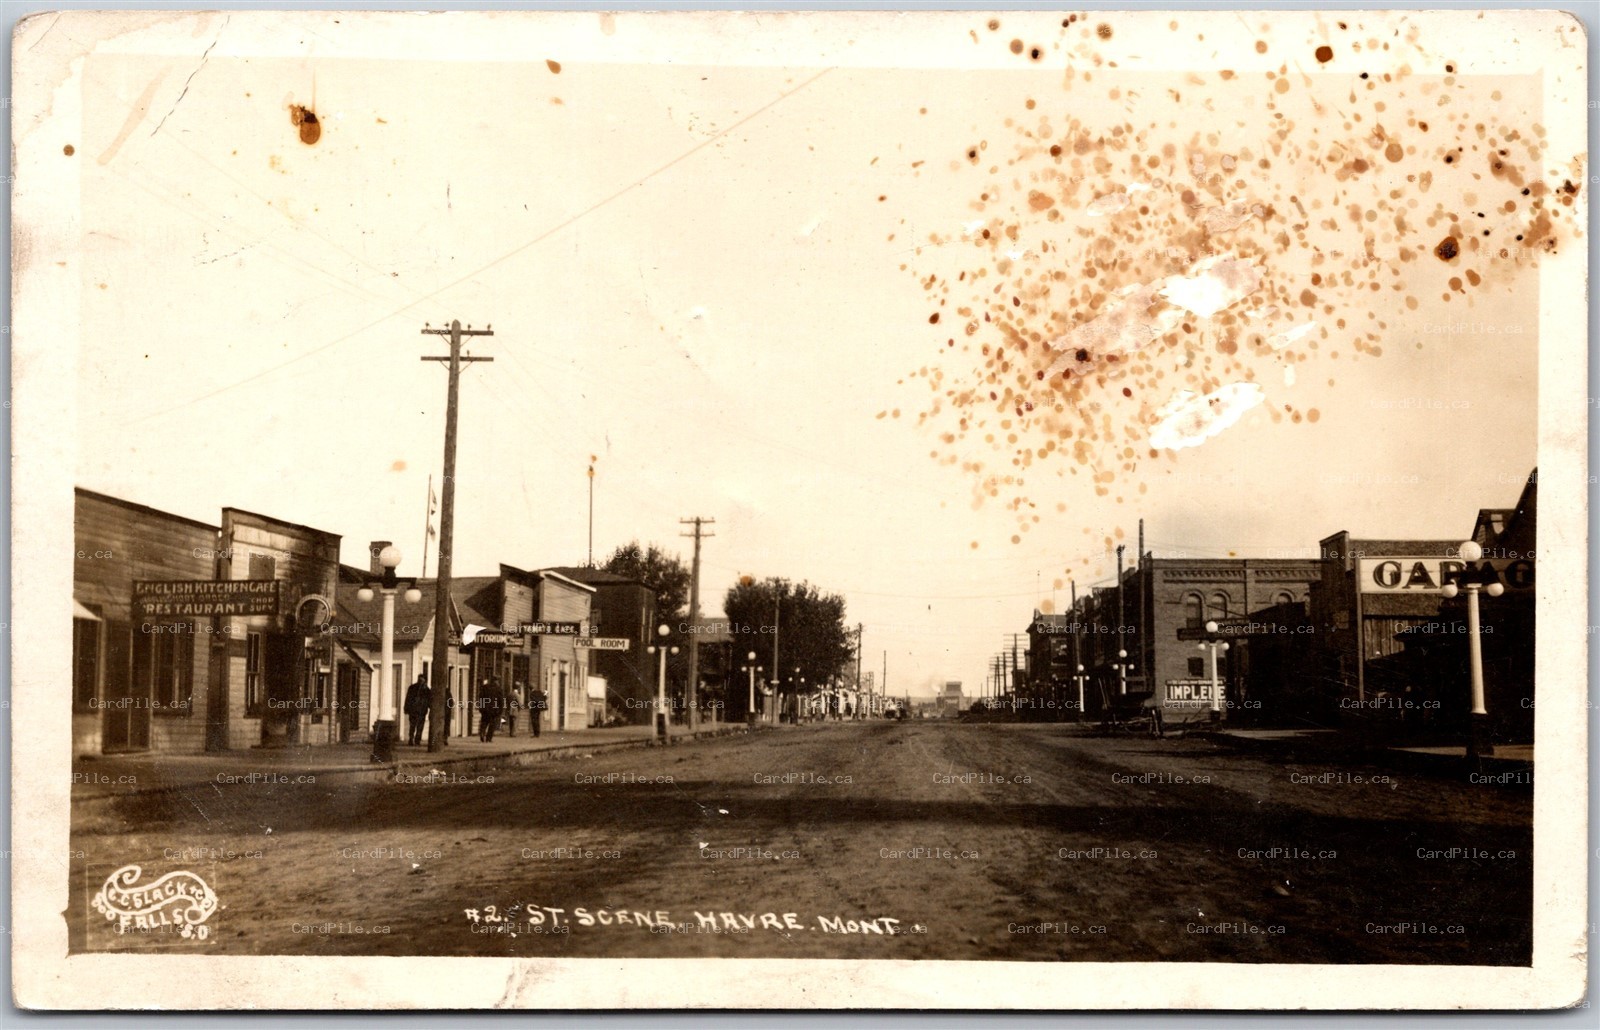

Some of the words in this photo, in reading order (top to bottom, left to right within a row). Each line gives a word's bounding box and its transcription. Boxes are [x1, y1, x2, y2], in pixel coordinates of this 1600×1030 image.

[136, 583, 193, 595] ENGLISH
[195, 582, 248, 593] KITCHEN
[145, 603, 247, 614] RESTAURANT
[575, 639, 596, 647] POOL
[600, 639, 625, 648] ROOM
